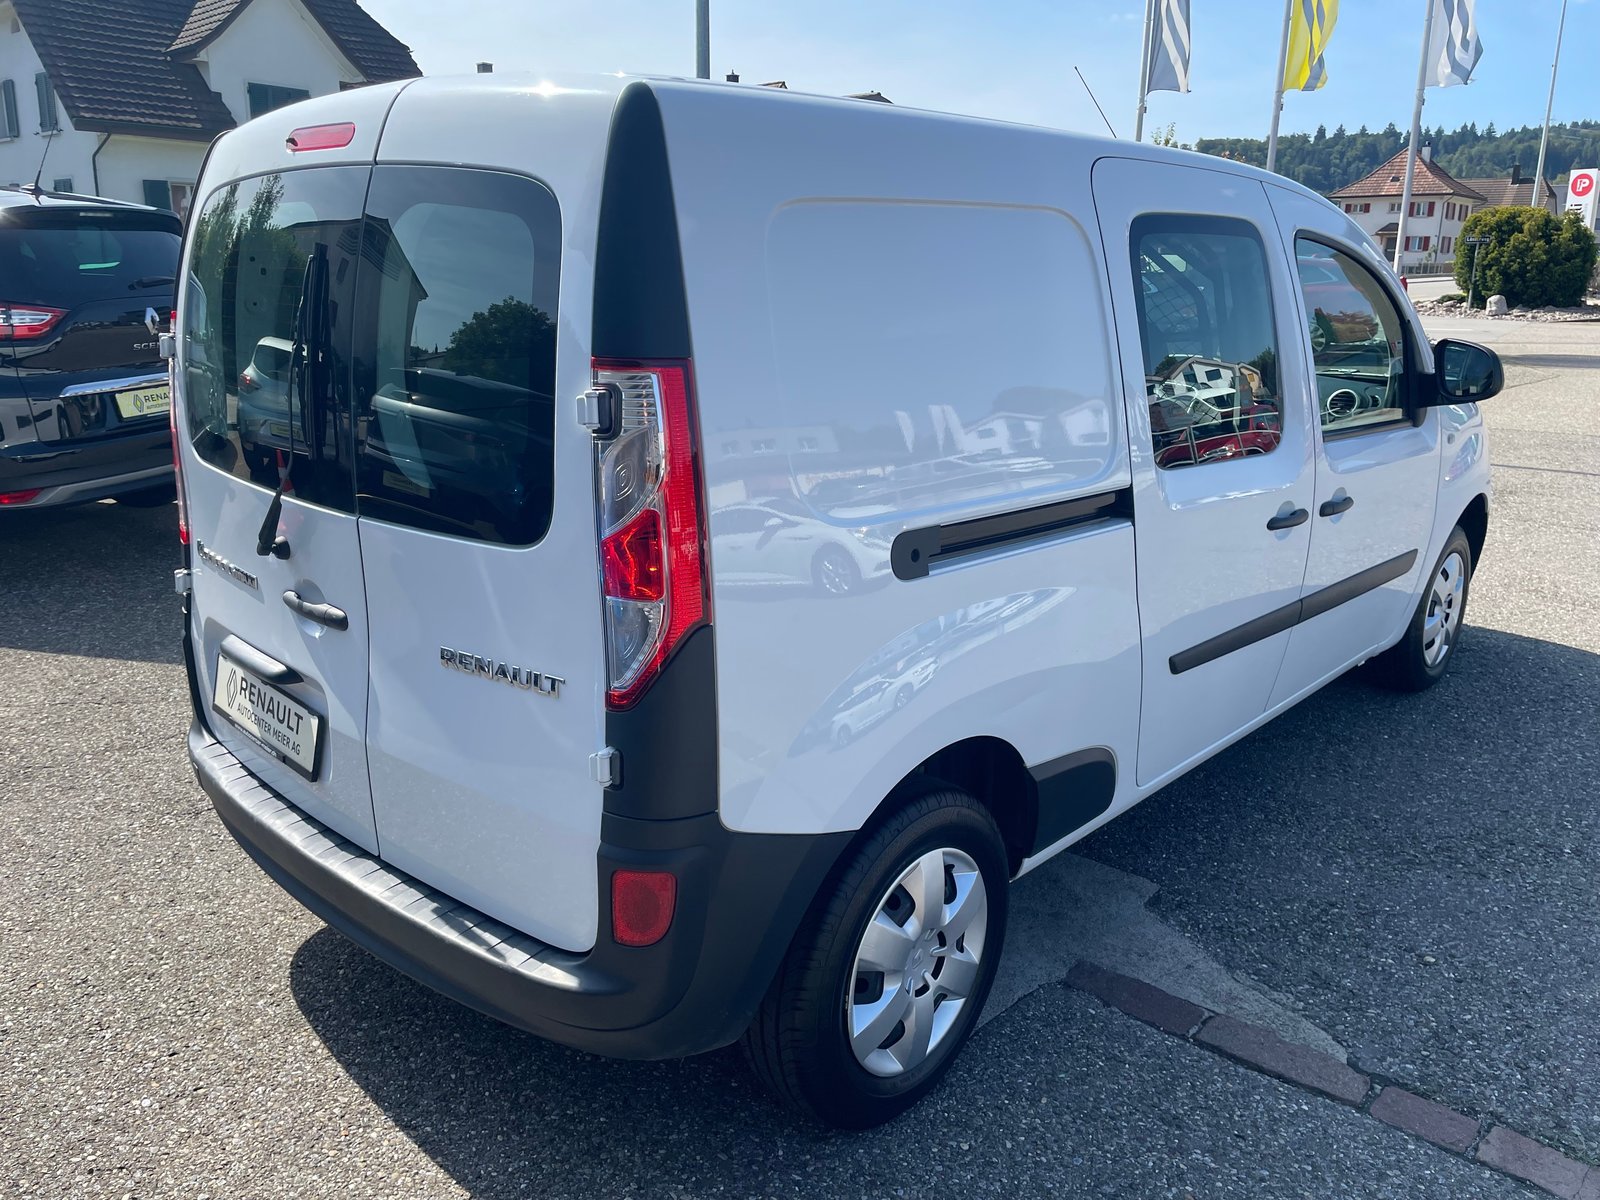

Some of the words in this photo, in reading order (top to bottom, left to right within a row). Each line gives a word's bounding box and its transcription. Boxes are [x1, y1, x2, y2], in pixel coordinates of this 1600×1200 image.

[144, 393, 169, 403] RENA
[440, 645, 565, 699] RENAULT
[237, 703, 272, 736] AUTOCENTER
[272, 727, 291, 750] MEIER
[291, 741, 301, 755] AG
[240, 676, 303, 735] RENAULT
